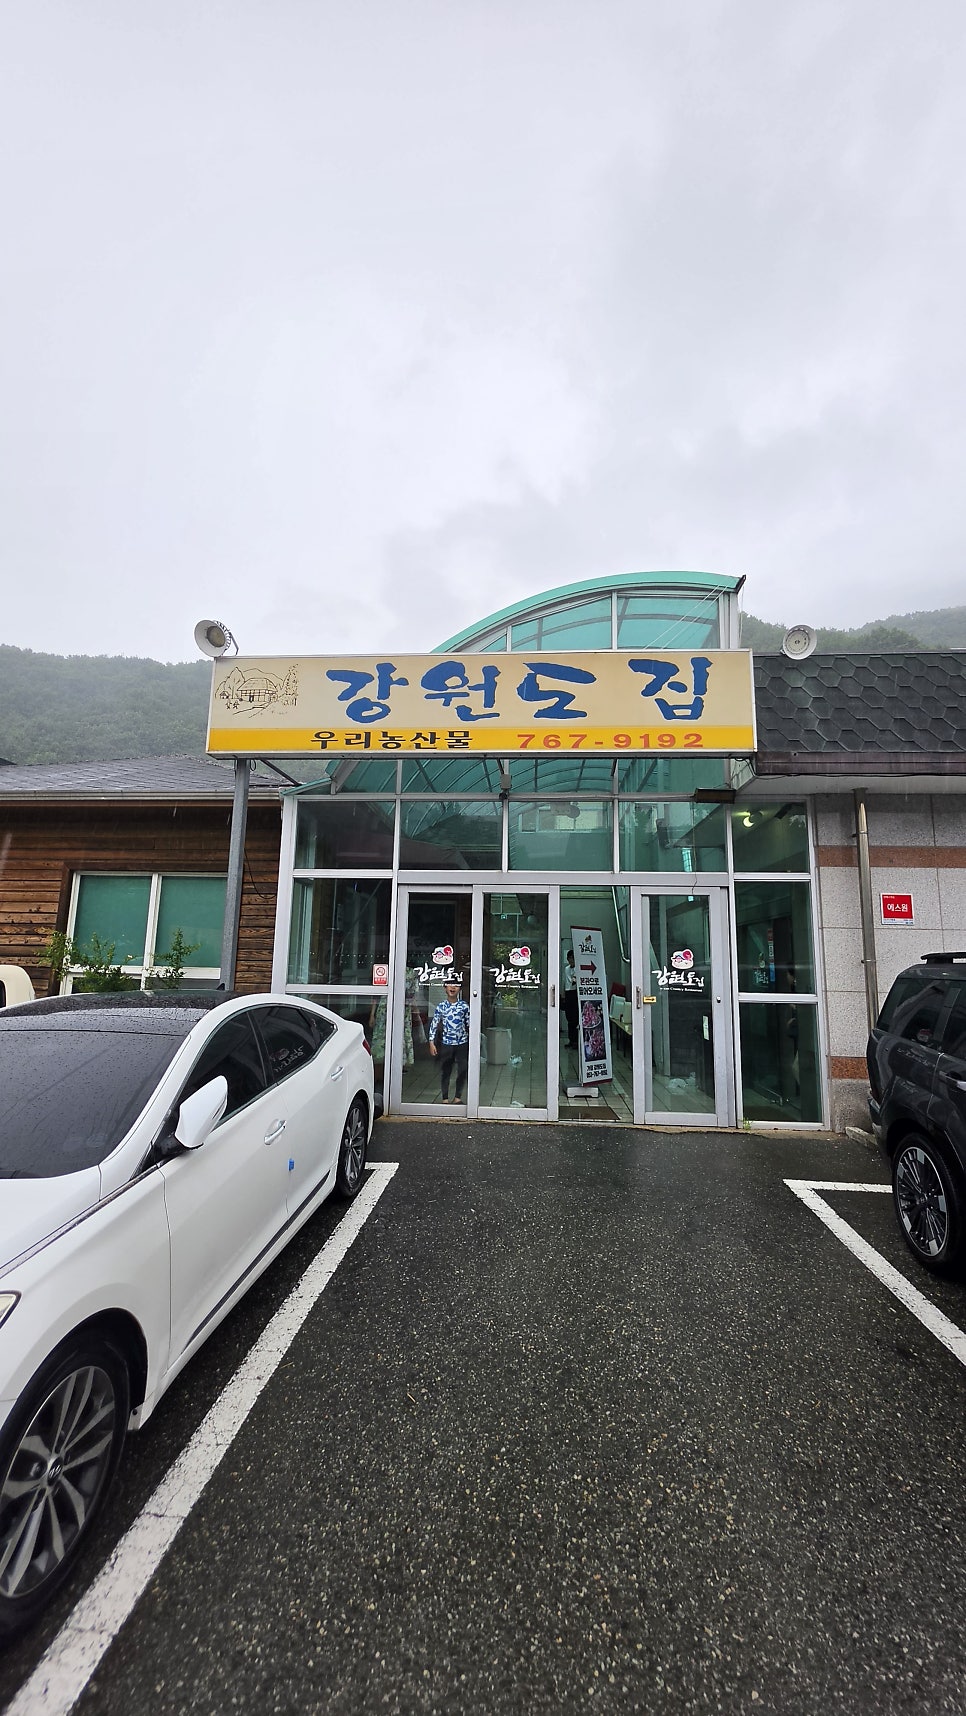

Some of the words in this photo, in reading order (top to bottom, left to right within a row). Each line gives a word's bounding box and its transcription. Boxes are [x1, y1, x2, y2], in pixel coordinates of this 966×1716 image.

[311, 731, 473, 749] 우리농산물
[517, 733, 703, 749] 767-9192
[887, 903, 908, 912] 에스원
[414, 963, 463, 982] 강원도집
[489, 964, 541, 984] 강원도집
[651, 966, 705, 987] 강원도집
[579, 987, 603, 995] 들어오세요
